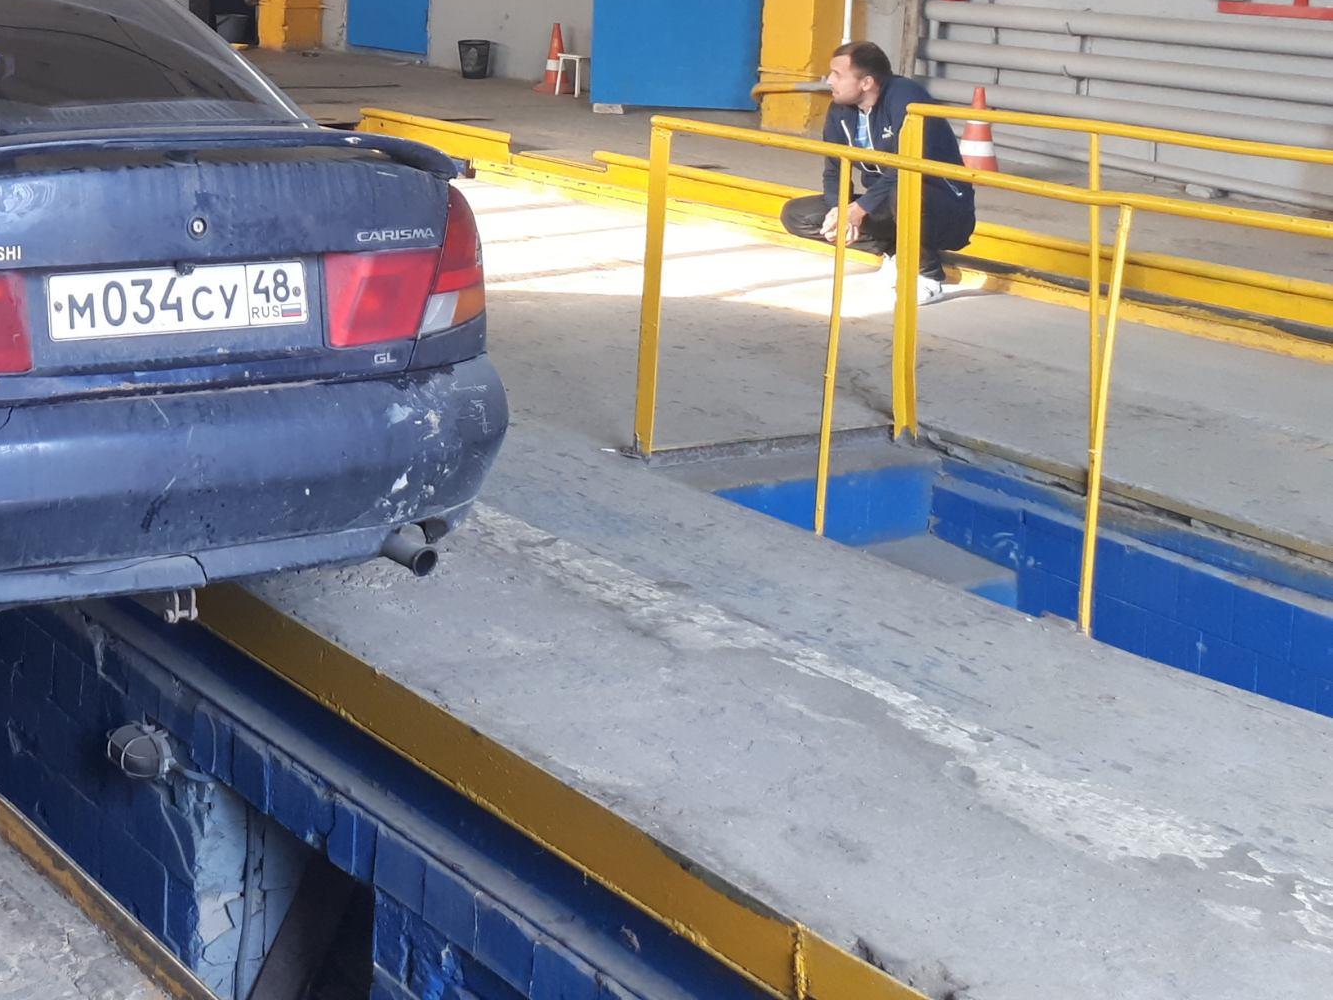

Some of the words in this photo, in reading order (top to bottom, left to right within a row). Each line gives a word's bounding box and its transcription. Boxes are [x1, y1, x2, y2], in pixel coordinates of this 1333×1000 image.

[356, 227, 436, 243] CARISMA
[67, 276, 239, 330] М034СУ
[252, 268, 291, 304] 48
[251, 304, 281, 319] RUS
[373, 352, 397, 365] GL
